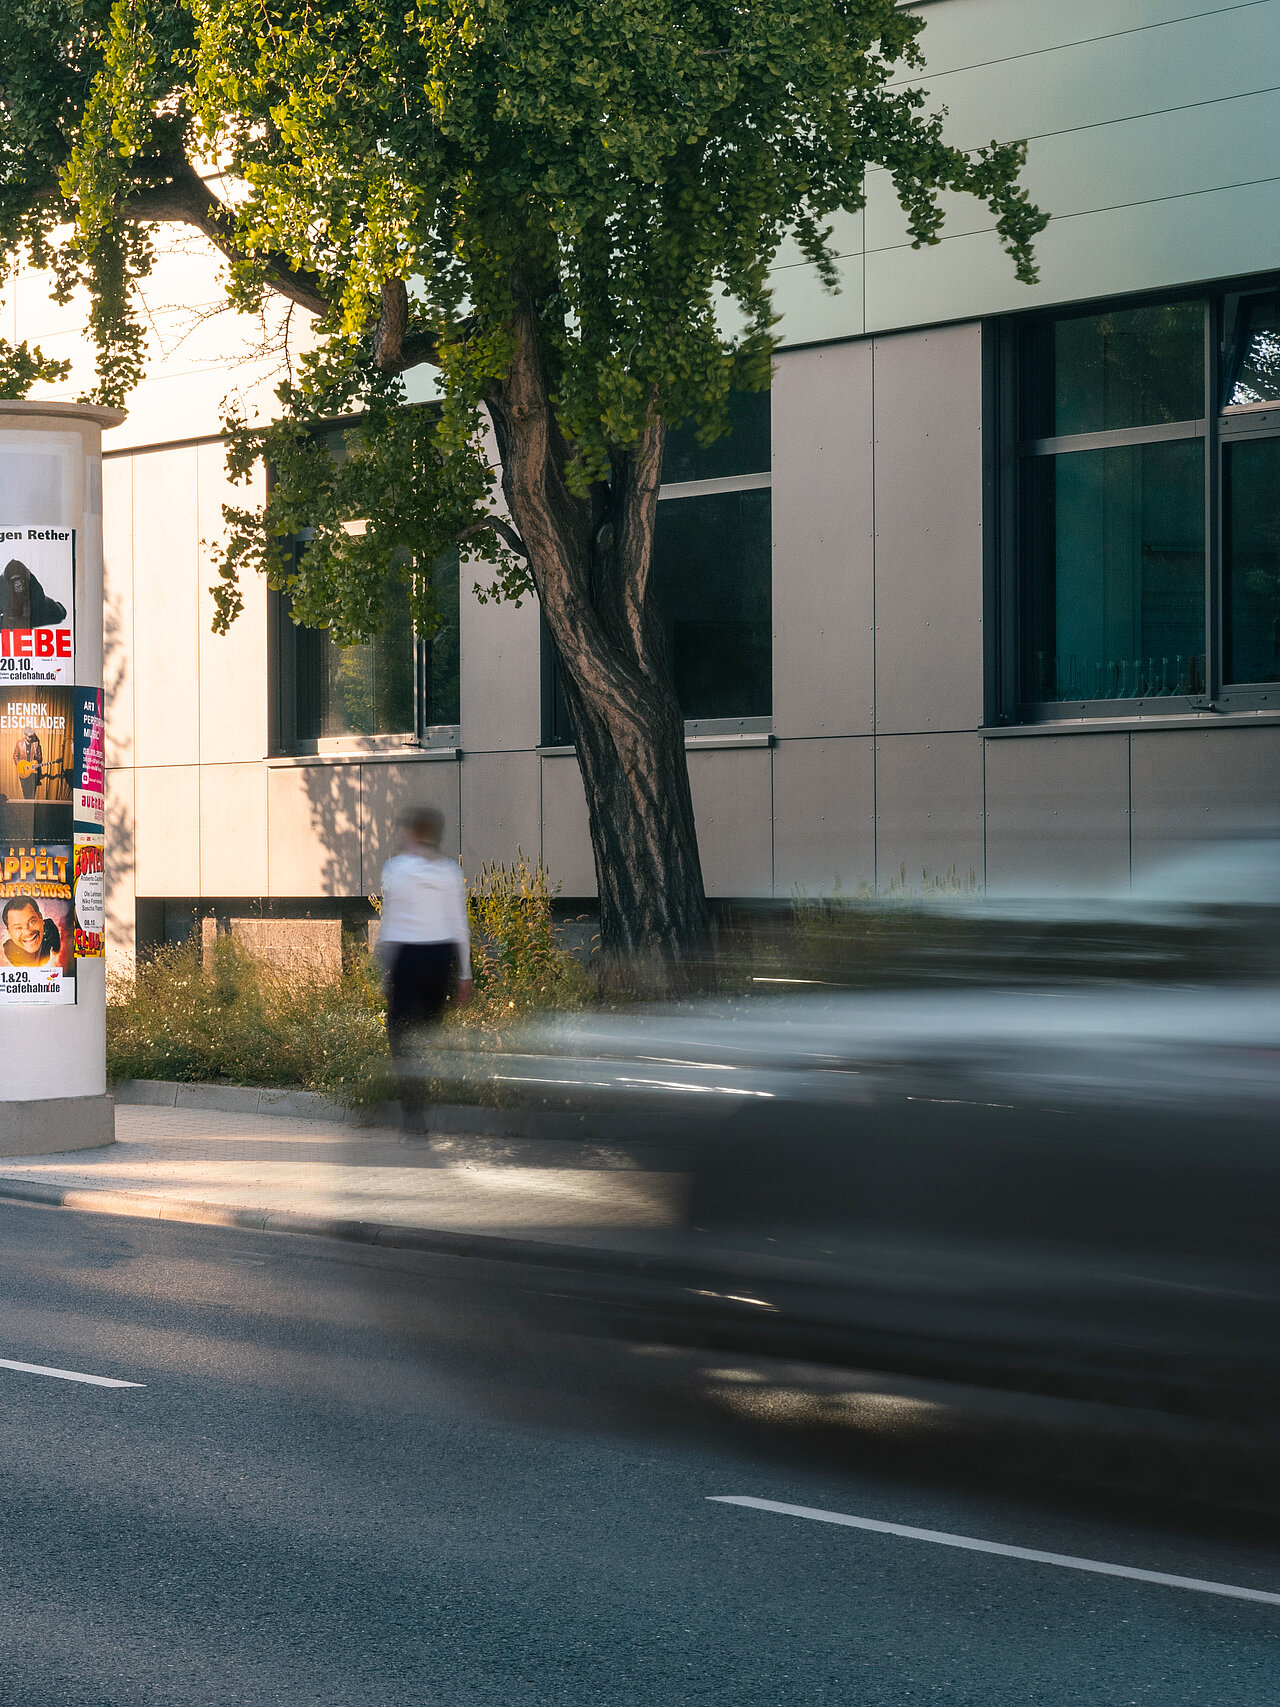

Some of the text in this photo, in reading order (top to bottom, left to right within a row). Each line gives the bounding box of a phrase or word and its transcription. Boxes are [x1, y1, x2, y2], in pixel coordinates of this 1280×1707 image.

[27, 529, 70, 541] Rether
[0, 658, 34, 671] 20.10.
[10, 671, 55, 680] cafehahn.de
[7, 702, 48, 716] HENRIK
[75, 928, 100, 950] CLUB
[6, 982, 61, 994] cafehahn.de
